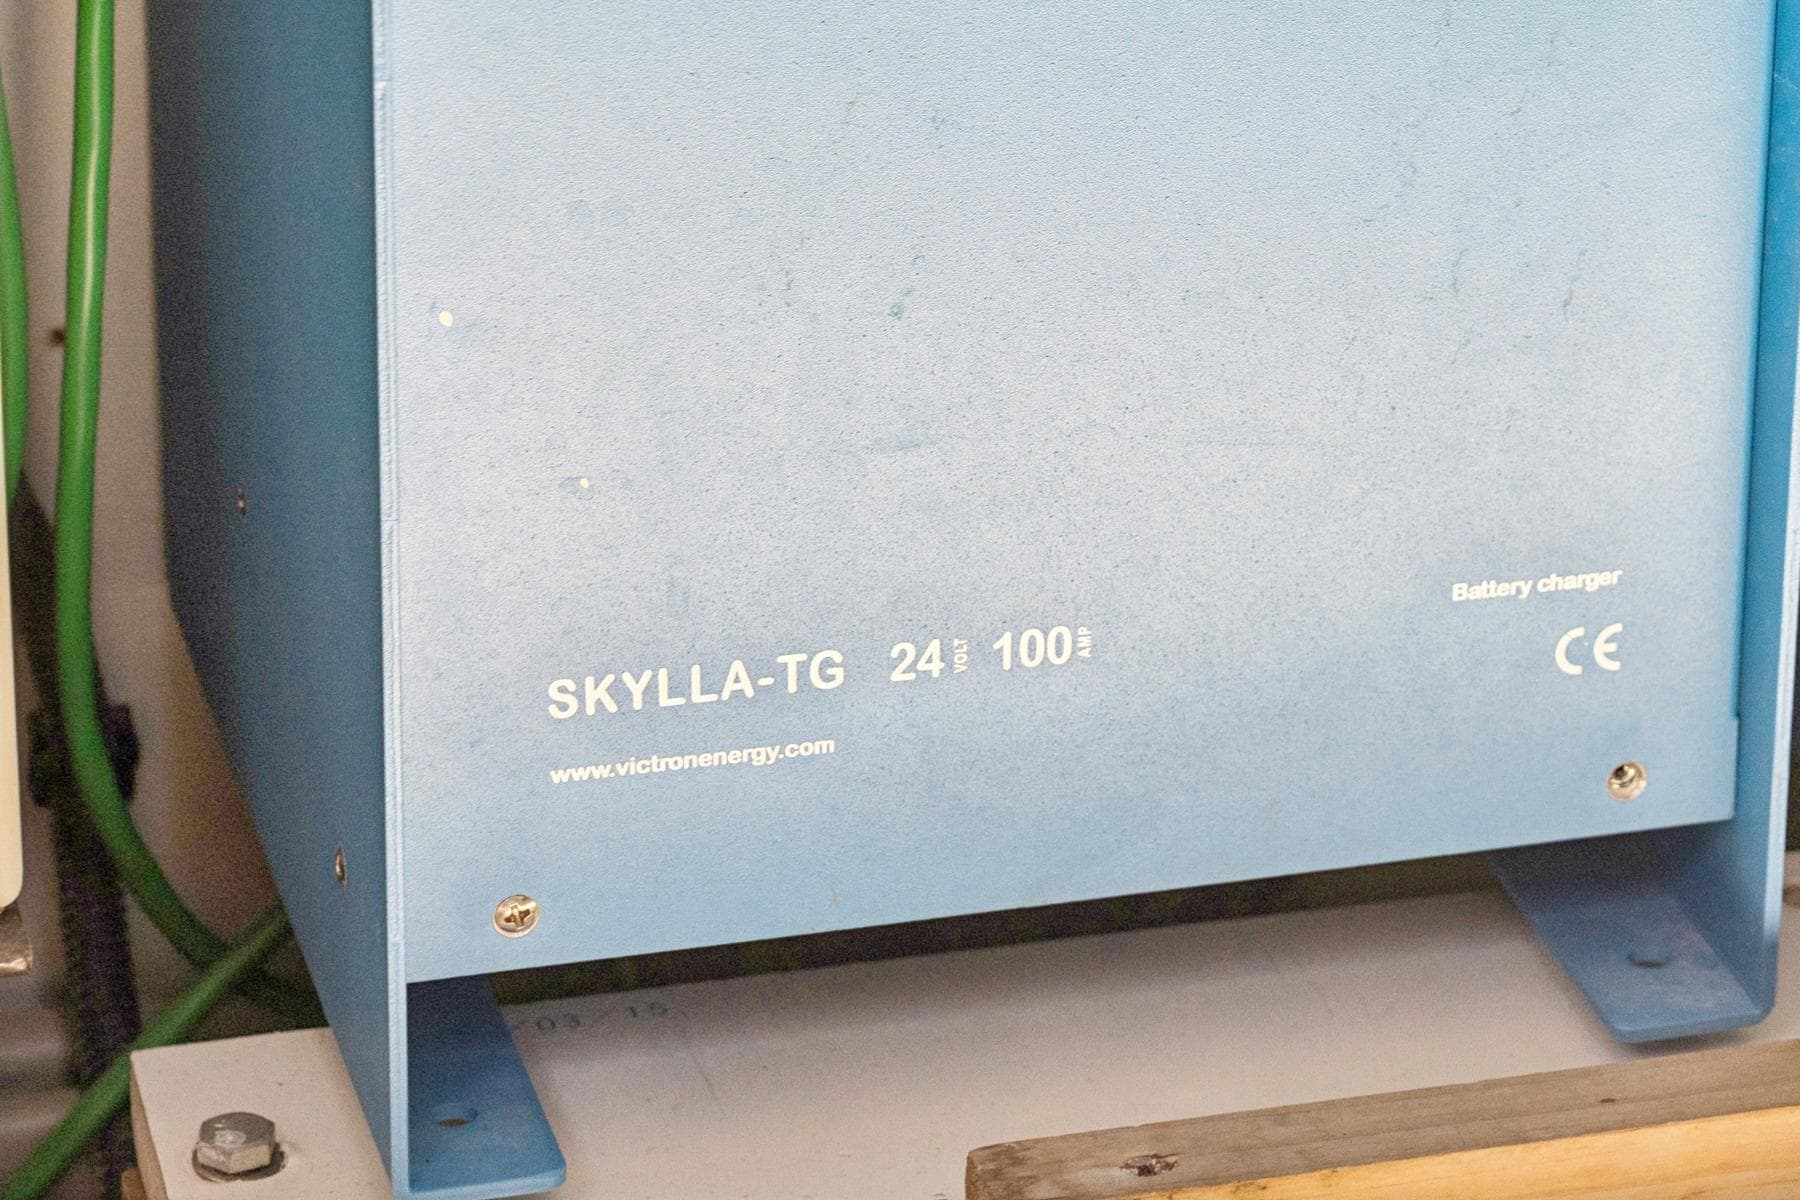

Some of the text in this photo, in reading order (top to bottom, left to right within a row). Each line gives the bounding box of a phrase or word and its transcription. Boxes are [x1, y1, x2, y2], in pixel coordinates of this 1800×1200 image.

[1452, 569, 1624, 602] Battery charger
[547, 625, 1093, 719] SKYLLA-TG 24 VOLT 100 AMP
[1554, 622, 1624, 676] CE
[549, 739, 836, 784] www.victronenergy.com
